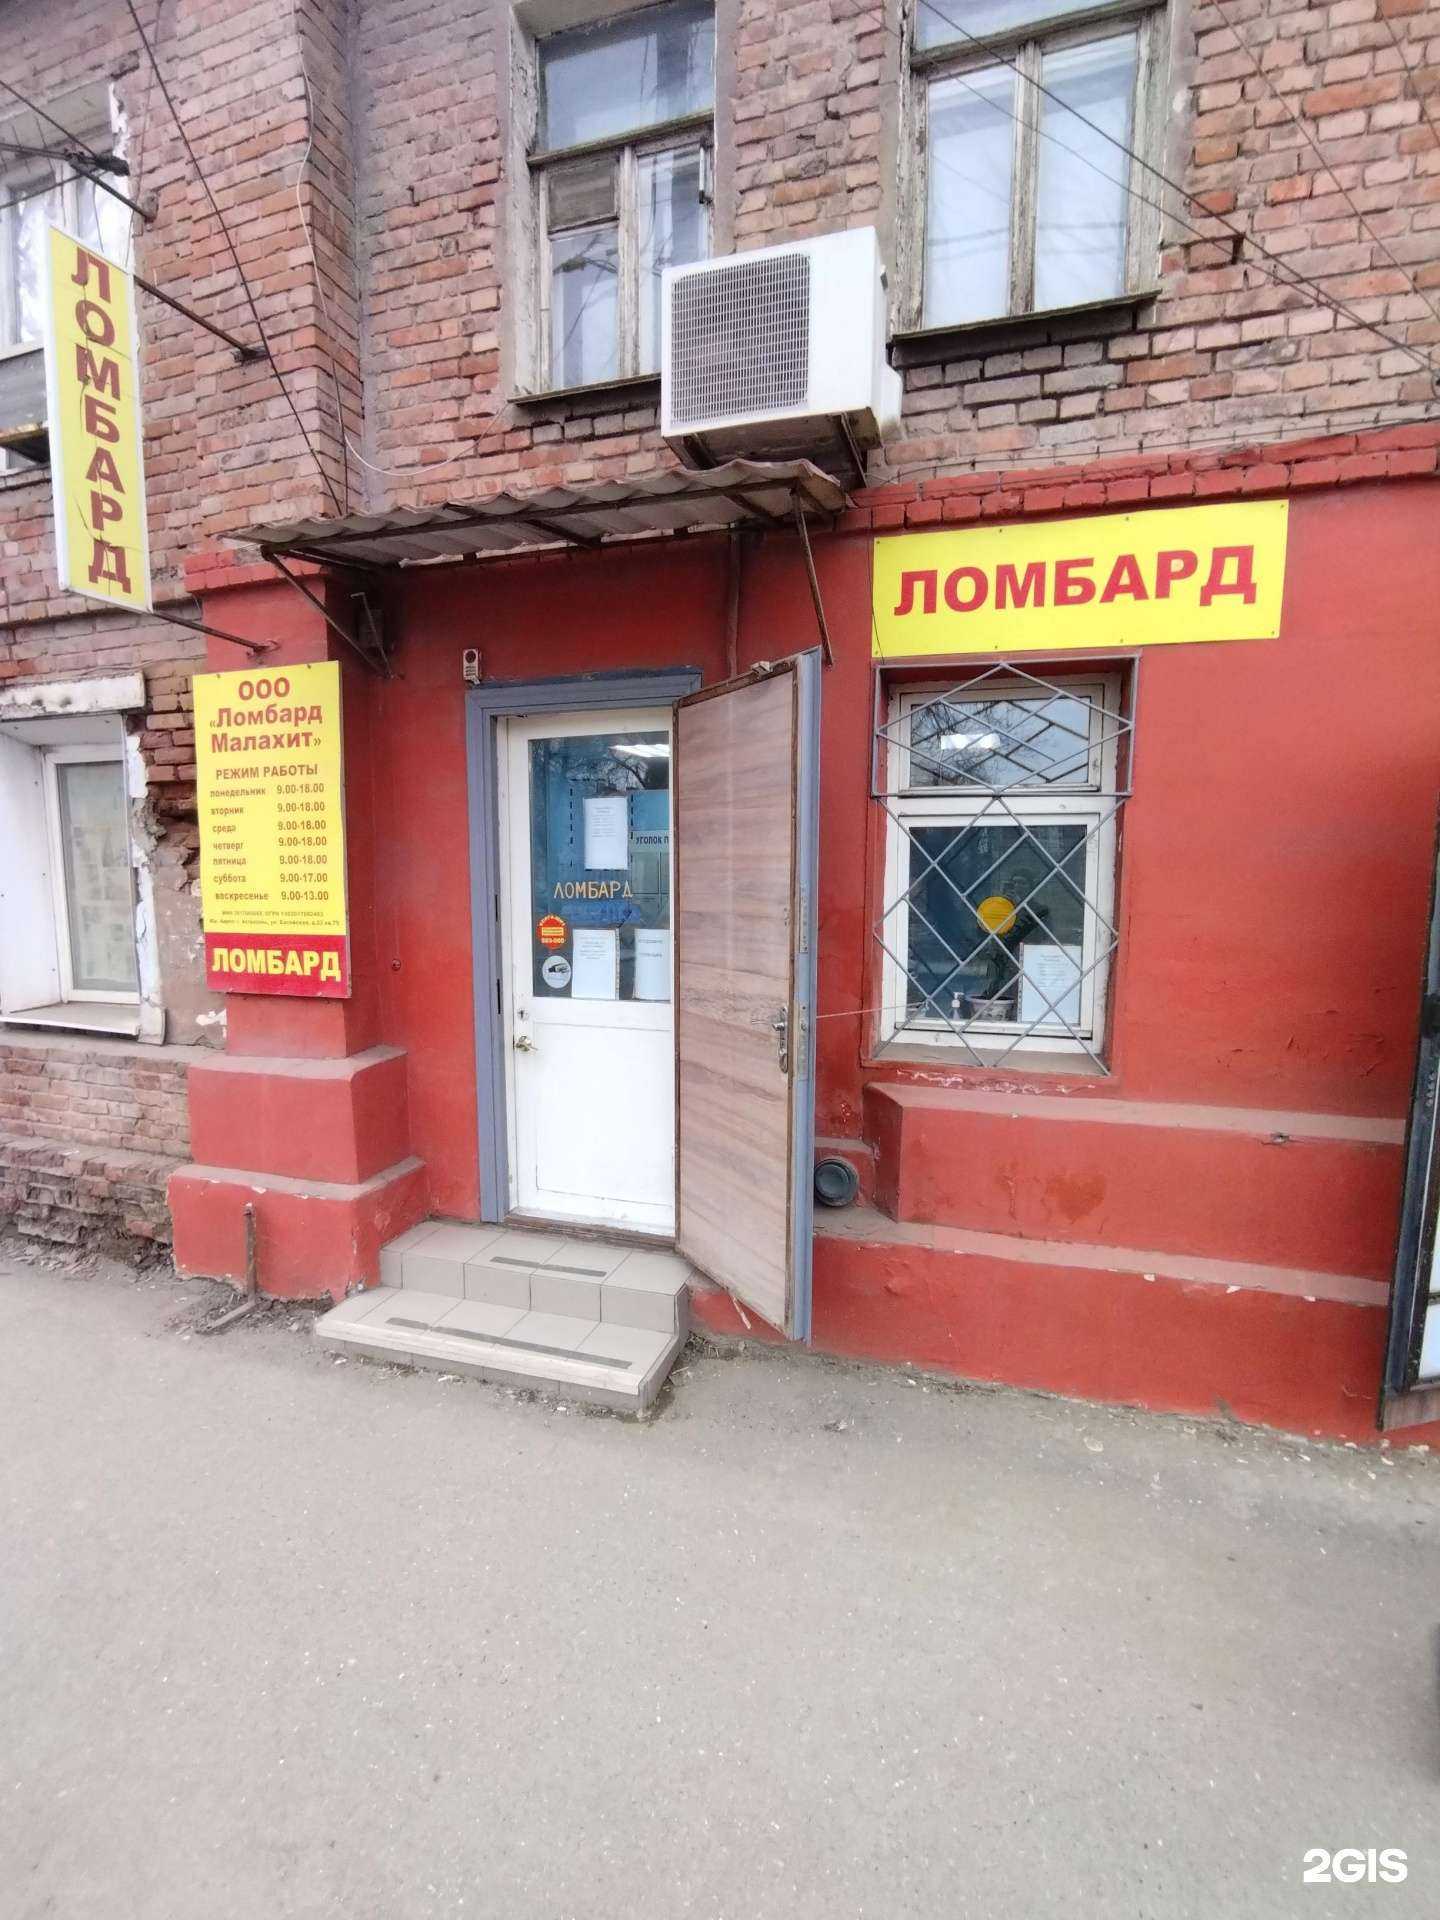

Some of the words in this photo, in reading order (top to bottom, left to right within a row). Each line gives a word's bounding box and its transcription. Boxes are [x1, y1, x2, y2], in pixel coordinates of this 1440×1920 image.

[71, 246, 131, 594] ЛОМБАРД
[894, 545, 1257, 616] ЛОМБАРД
[238, 677, 290, 700] ООО
[210, 704, 323, 728] «Ломбард
[211, 732, 322, 753] Малахит»
[216, 767, 259, 780] РЕЖИМ
[263, 764, 318, 777] РАБОТЫ
[276, 783, 325, 794] 9.00-18.00
[277, 802, 325, 812] 9.00-18.00
[278, 820, 326, 830] 9.00-18.00
[278, 837, 327, 846] 9.00-18.00
[279, 855, 327, 864] 9.00-18.00
[280, 873, 328, 882] 9.00-17.00
[281, 891, 329, 900] 9.00-13.00
[553, 880, 633, 899] ЛОМБАРД
[211, 948, 341, 982] ЛОМБАРД
